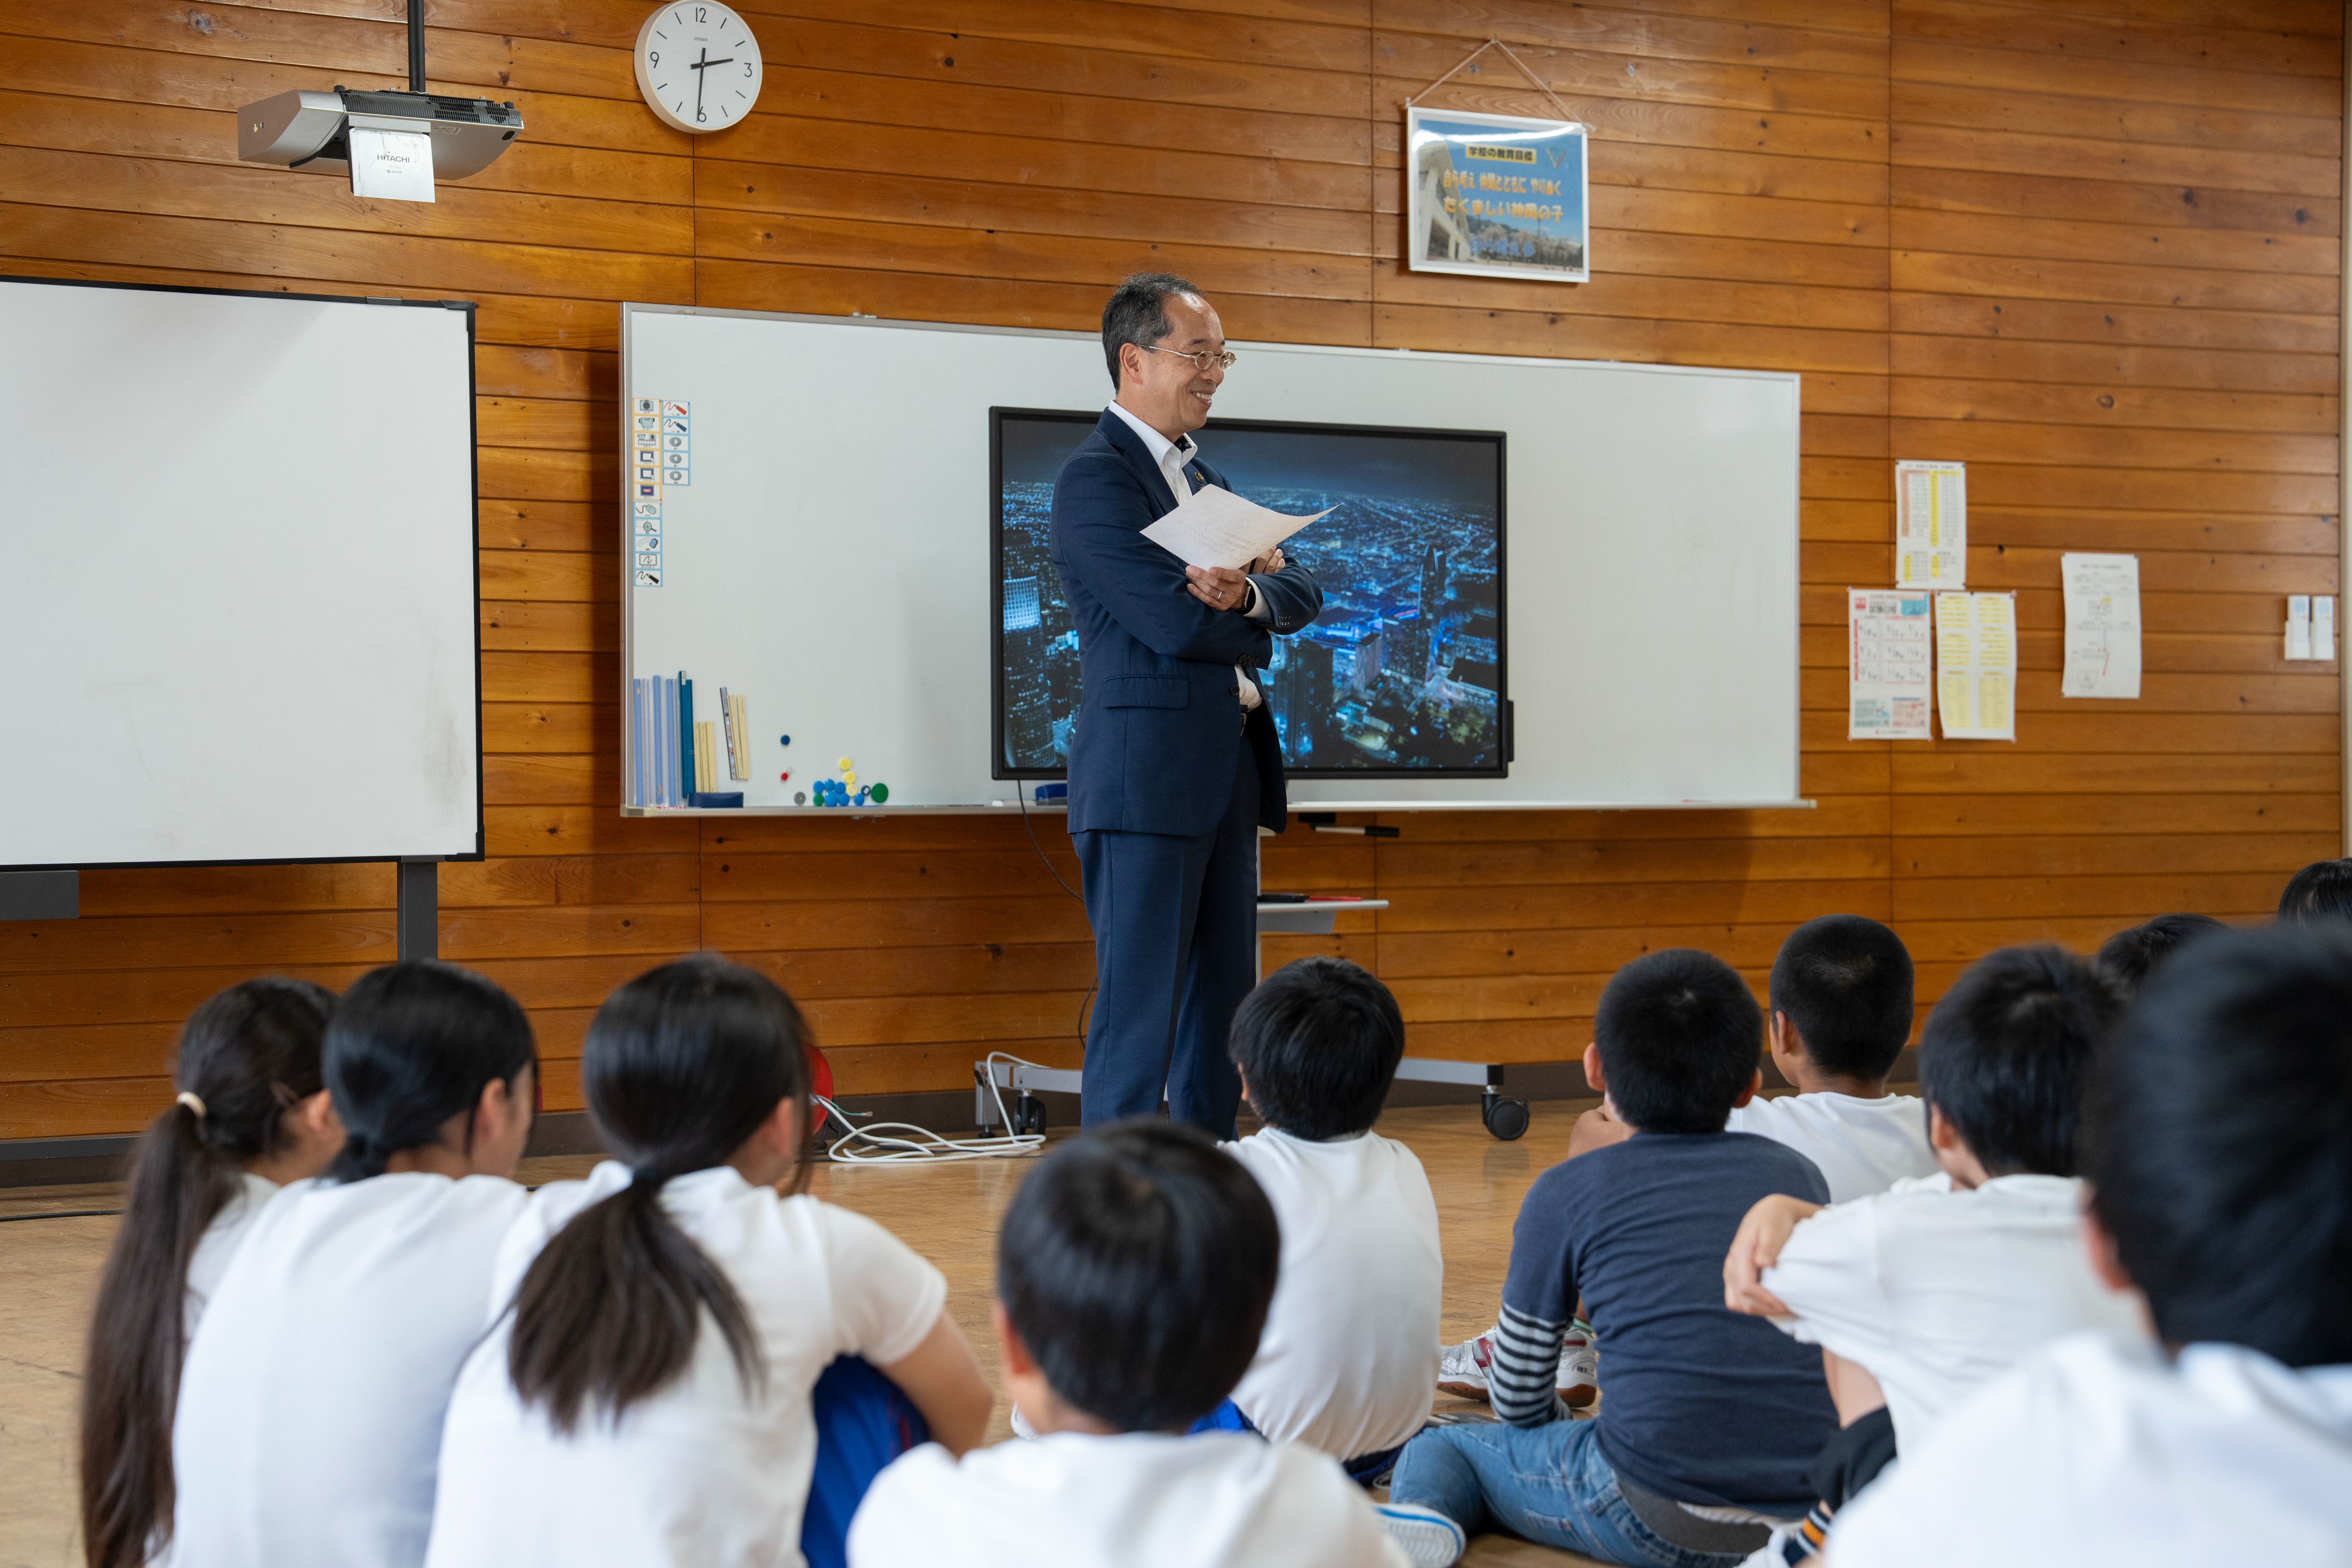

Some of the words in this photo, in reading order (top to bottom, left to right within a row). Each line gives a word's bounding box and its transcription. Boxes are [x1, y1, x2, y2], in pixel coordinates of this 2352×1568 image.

[695, 7, 707, 23] 12
[650, 52, 660, 69] 9
[744, 63, 752, 78] 3
[697, 106, 707, 122] 6
[377, 154, 410, 163] HITACHI
[1469, 147, 1532, 161] 学校の教育目標
